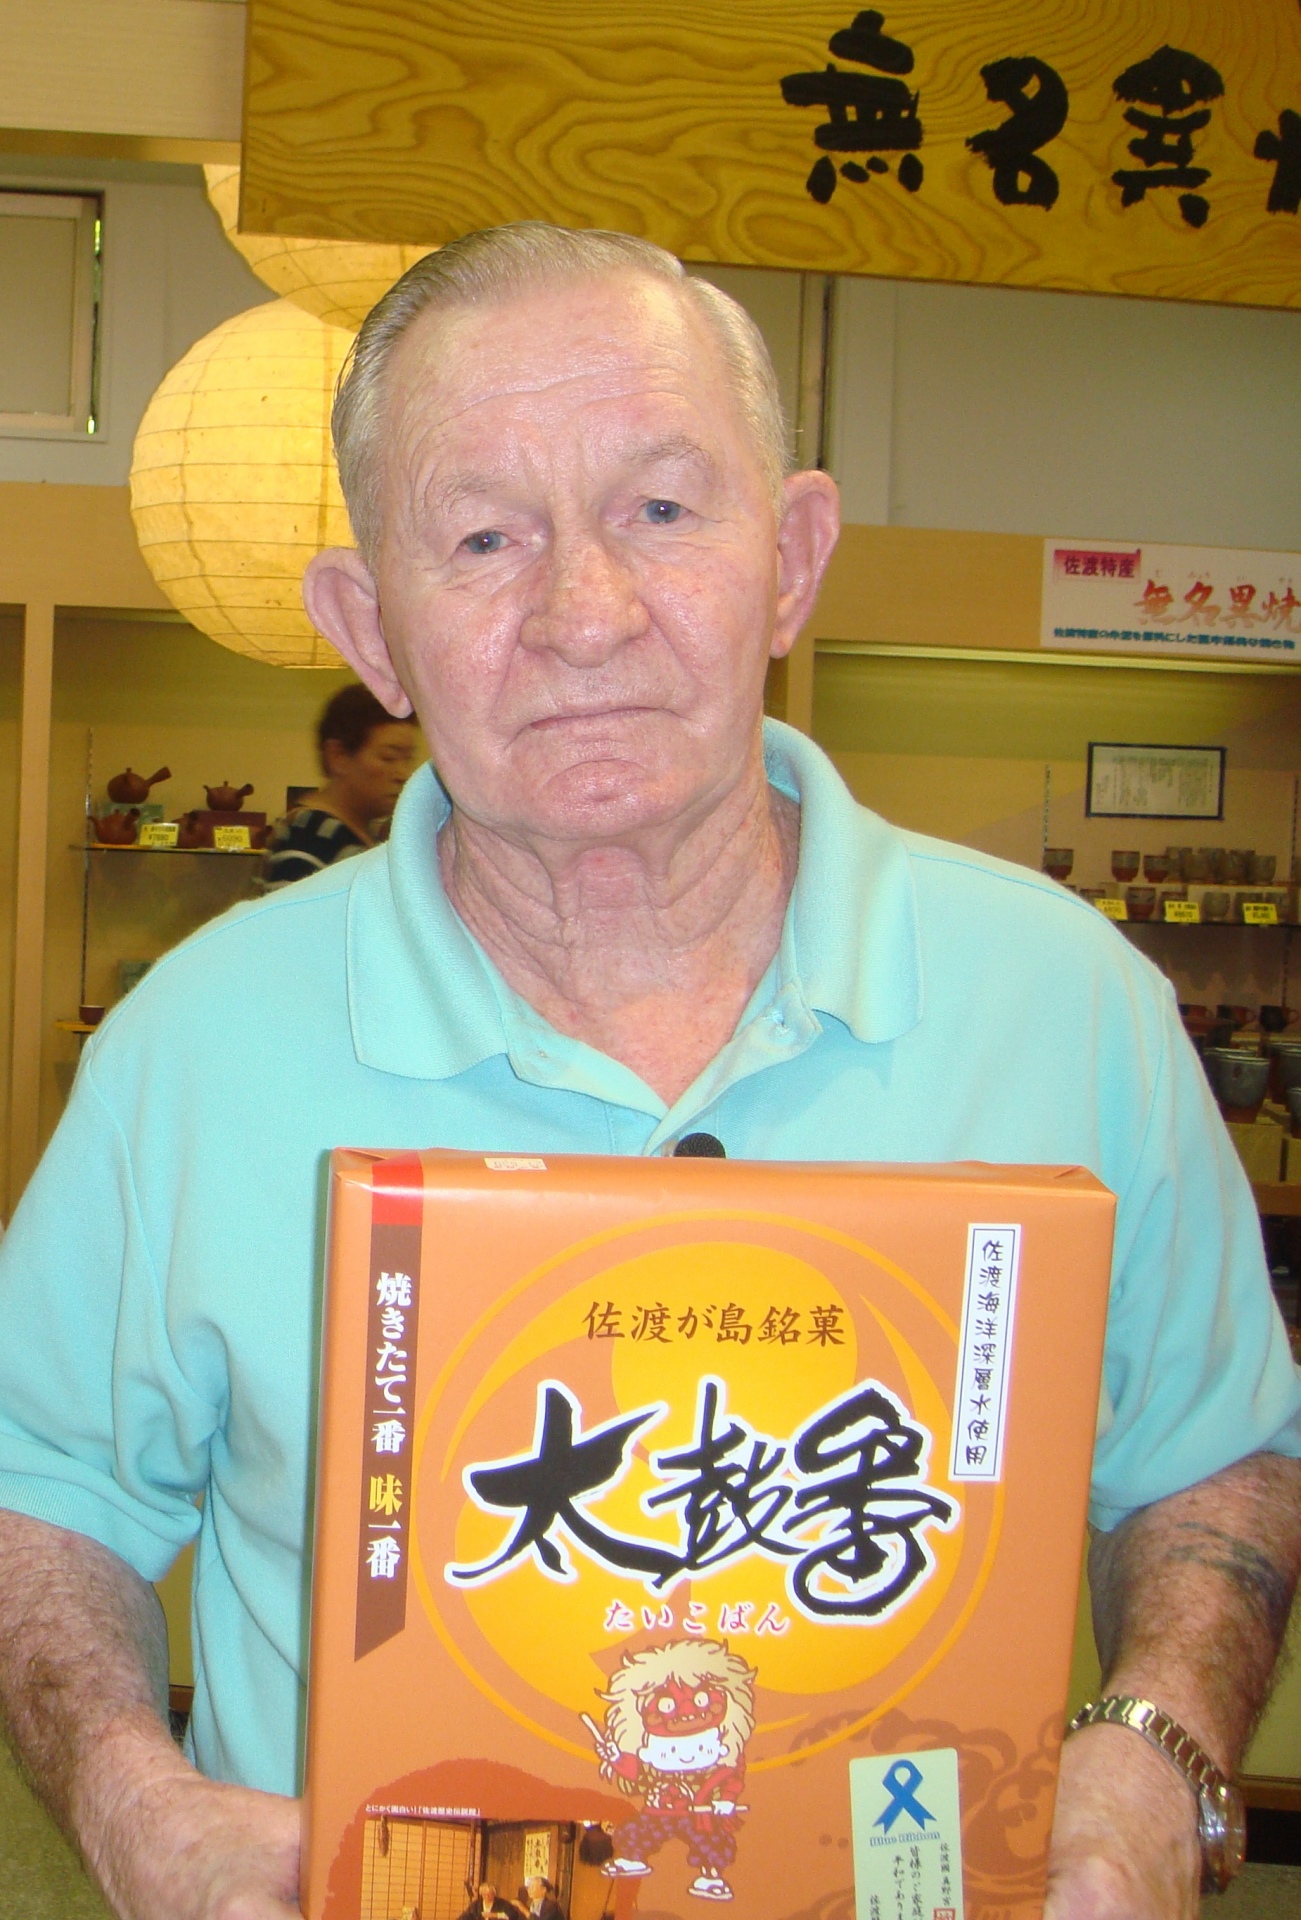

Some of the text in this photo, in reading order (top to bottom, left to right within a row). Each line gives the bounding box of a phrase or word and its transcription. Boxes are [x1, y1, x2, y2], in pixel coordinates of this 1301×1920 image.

[1064, 556, 1135, 579] 佐渡特産
[582, 1300, 847, 1347] 佐渡が島銘菓
[366, 1272, 413, 1579] 焼きたて一番 味一番
[603, 1601, 786, 1633] たいこばん
